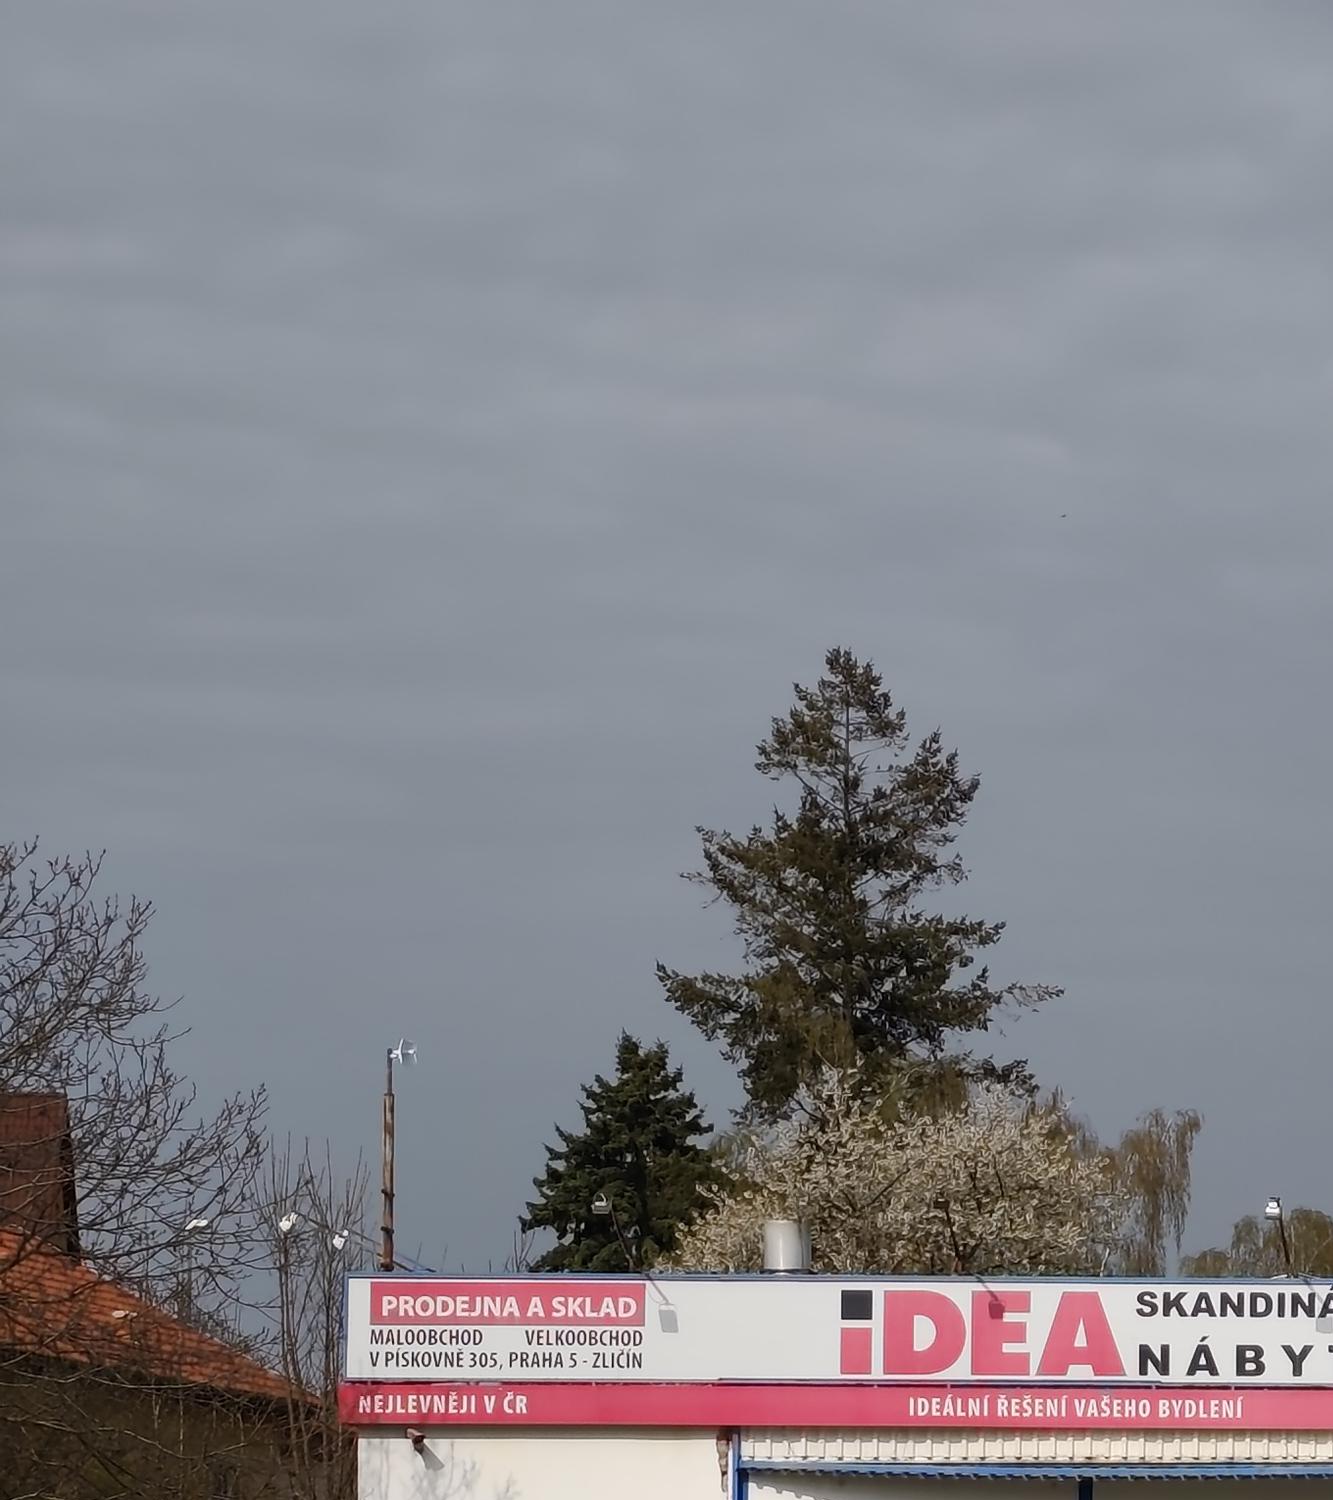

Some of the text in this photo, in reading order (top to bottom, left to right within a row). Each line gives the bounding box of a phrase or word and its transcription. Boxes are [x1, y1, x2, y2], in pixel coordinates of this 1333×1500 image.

[381, 1295, 637, 1318] PRODEJNA A SKLAD
[370, 1329, 643, 1346] MALOOBCHOD VELKOOBCHOD
[370, 1351, 380, 1367] V
[384, 1347, 463, 1368] PÍSKOVNĚ
[469, 1352, 502, 1371] 305,
[509, 1352, 563, 1368] PRAHA
[568, 1353, 578, 1368] 5
[592, 1348, 643, 1369] ZLIČÍN
[359, 1391, 528, 1414] NEJLEVNĚJI V ČR
[909, 1393, 1243, 1419] IDEÁLNÍ ŘEŠENÍ VAŠEHO BYDLENÍ
